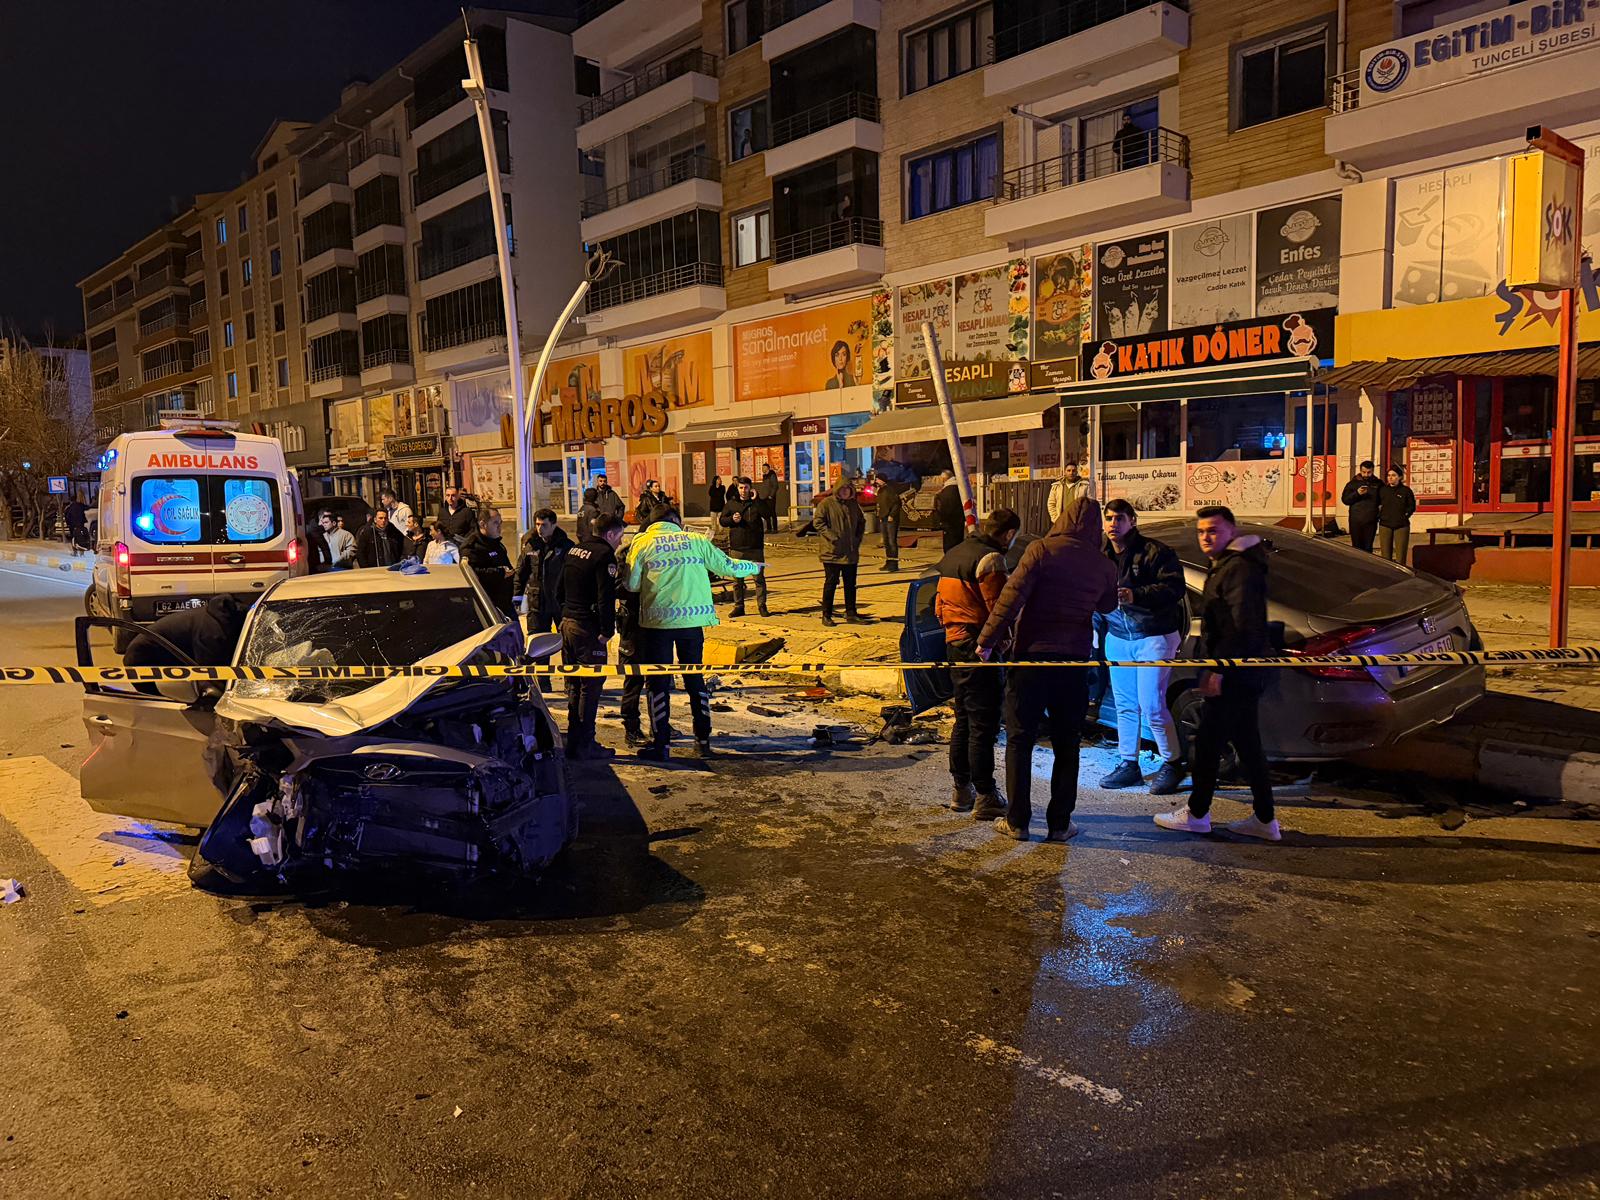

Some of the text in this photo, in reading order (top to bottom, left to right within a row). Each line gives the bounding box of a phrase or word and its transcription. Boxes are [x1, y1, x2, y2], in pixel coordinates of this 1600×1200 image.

[1472, 42, 1535, 70] TUNCELİ
[1418, 173, 1472, 194] HESAPLI
[1280, 245, 1321, 264] Enfes
[1222, 265, 1248, 276] Lezzet
[1118, 324, 1282, 373] KATIK DÖNER
[945, 362, 994, 383] ESAPLI
[147, 453, 258, 470] AMBULANS
